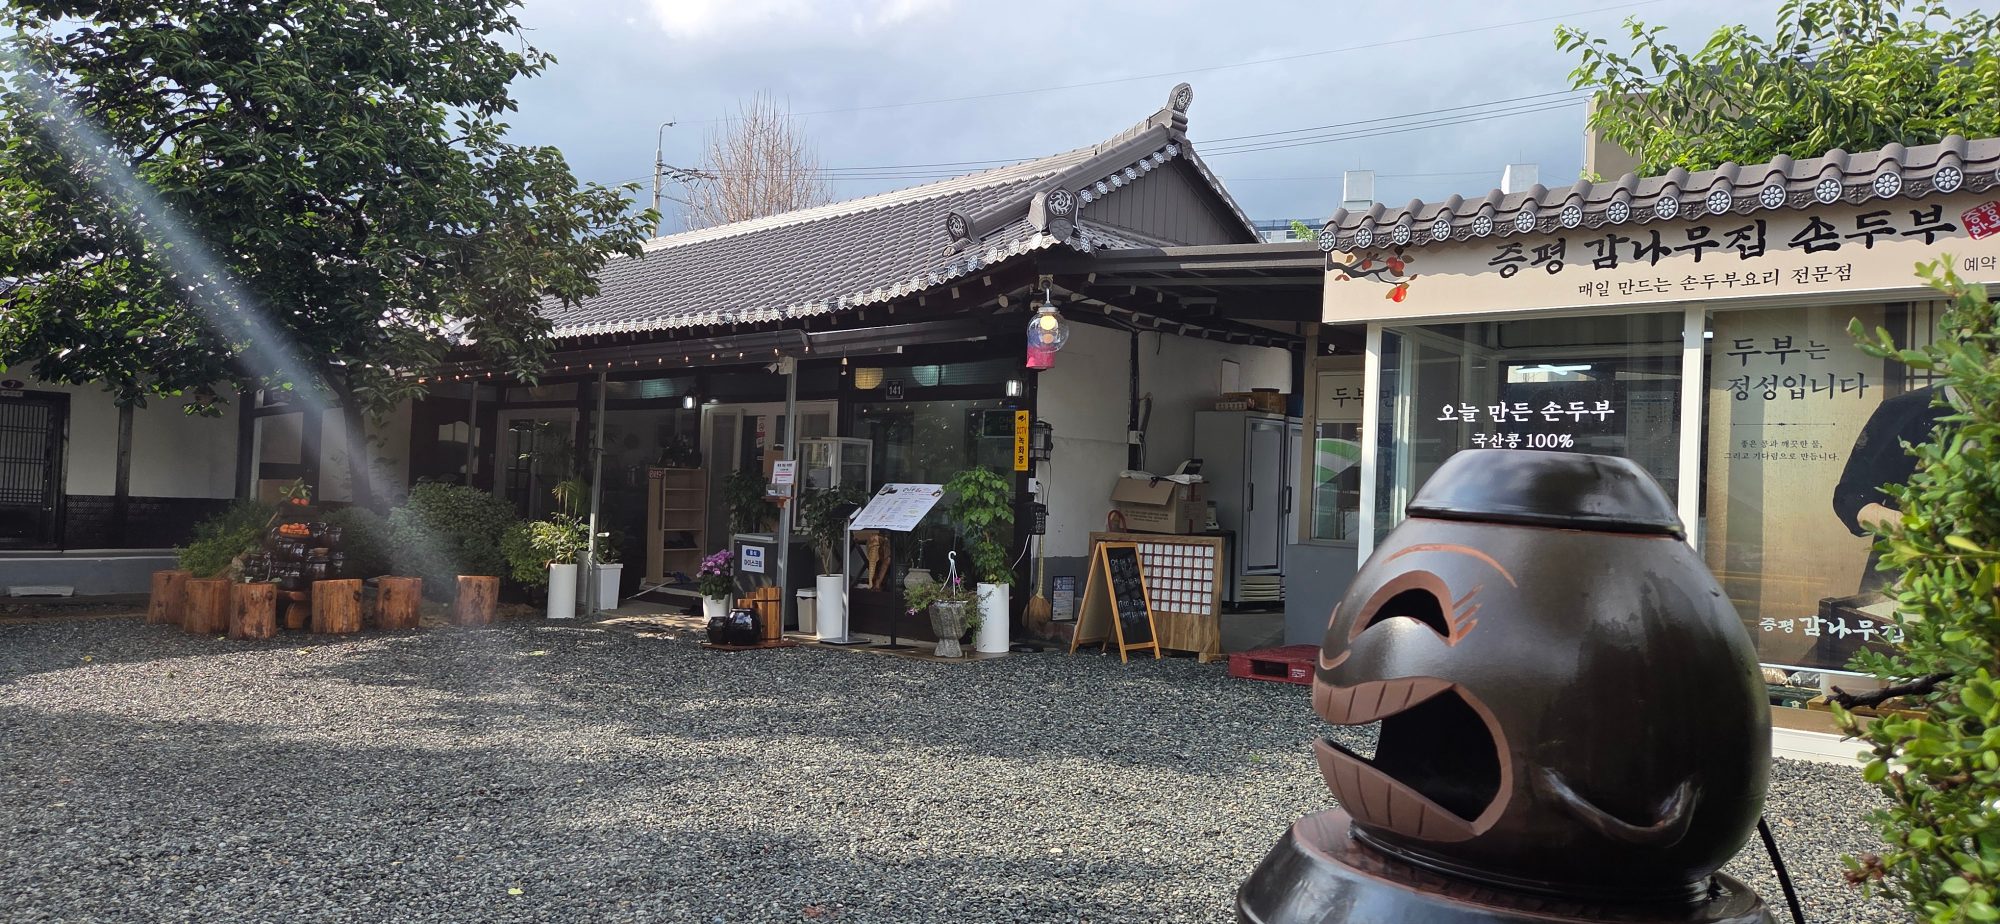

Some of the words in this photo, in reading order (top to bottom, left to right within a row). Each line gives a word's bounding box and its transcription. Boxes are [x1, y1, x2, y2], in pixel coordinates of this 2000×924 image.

[1488, 238, 1566, 278] 증평
[1584, 219, 1766, 270] 감나무집
[1788, 204, 1957, 254] 손두부
[1964, 256, 1997, 271] 예약
[1579, 281, 1610, 298] 매일
[1618, 277, 1672, 296] 만드는
[1680, 268, 1779, 291] 손두부요리
[1791, 263, 1852, 285] 전문점
[1727, 335, 1830, 367] 두부는
[888, 385, 901, 395] 141
[1726, 372, 1869, 400] 정성입니다
[1437, 403, 1480, 422] 오늘
[1488, 400, 1533, 422] 만든
[1540, 400, 1615, 422] 손두부
[1471, 433, 1521, 449] 국산콩
[1526, 433, 1574, 449] 100%
[1724, 452, 1749, 460] 그리고
[1755, 452, 1797, 460] 기다림으로
[1800, 452, 1840, 461] 만듭니다.
[1759, 617, 1794, 634] 증평
[1799, 616, 1905, 643] 감나무집
